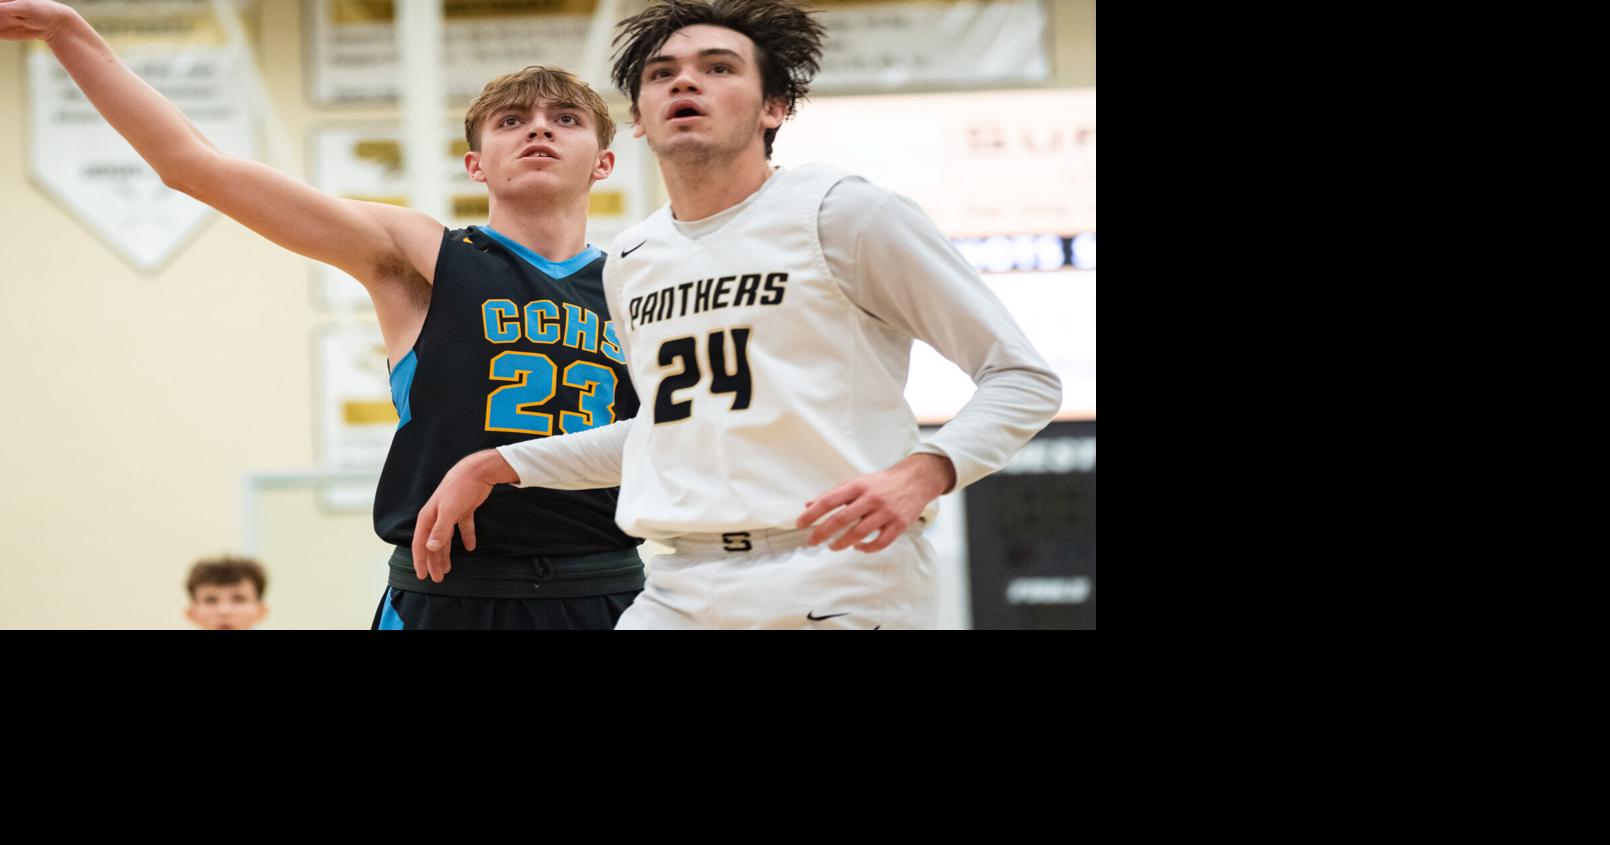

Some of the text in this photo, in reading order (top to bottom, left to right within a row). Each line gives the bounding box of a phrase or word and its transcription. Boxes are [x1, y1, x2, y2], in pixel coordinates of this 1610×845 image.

[481, 298, 626, 365] CCHS
[629, 272, 789, 331] PANTHERS
[484, 350, 618, 436] 23
[653, 326, 753, 426] 24
